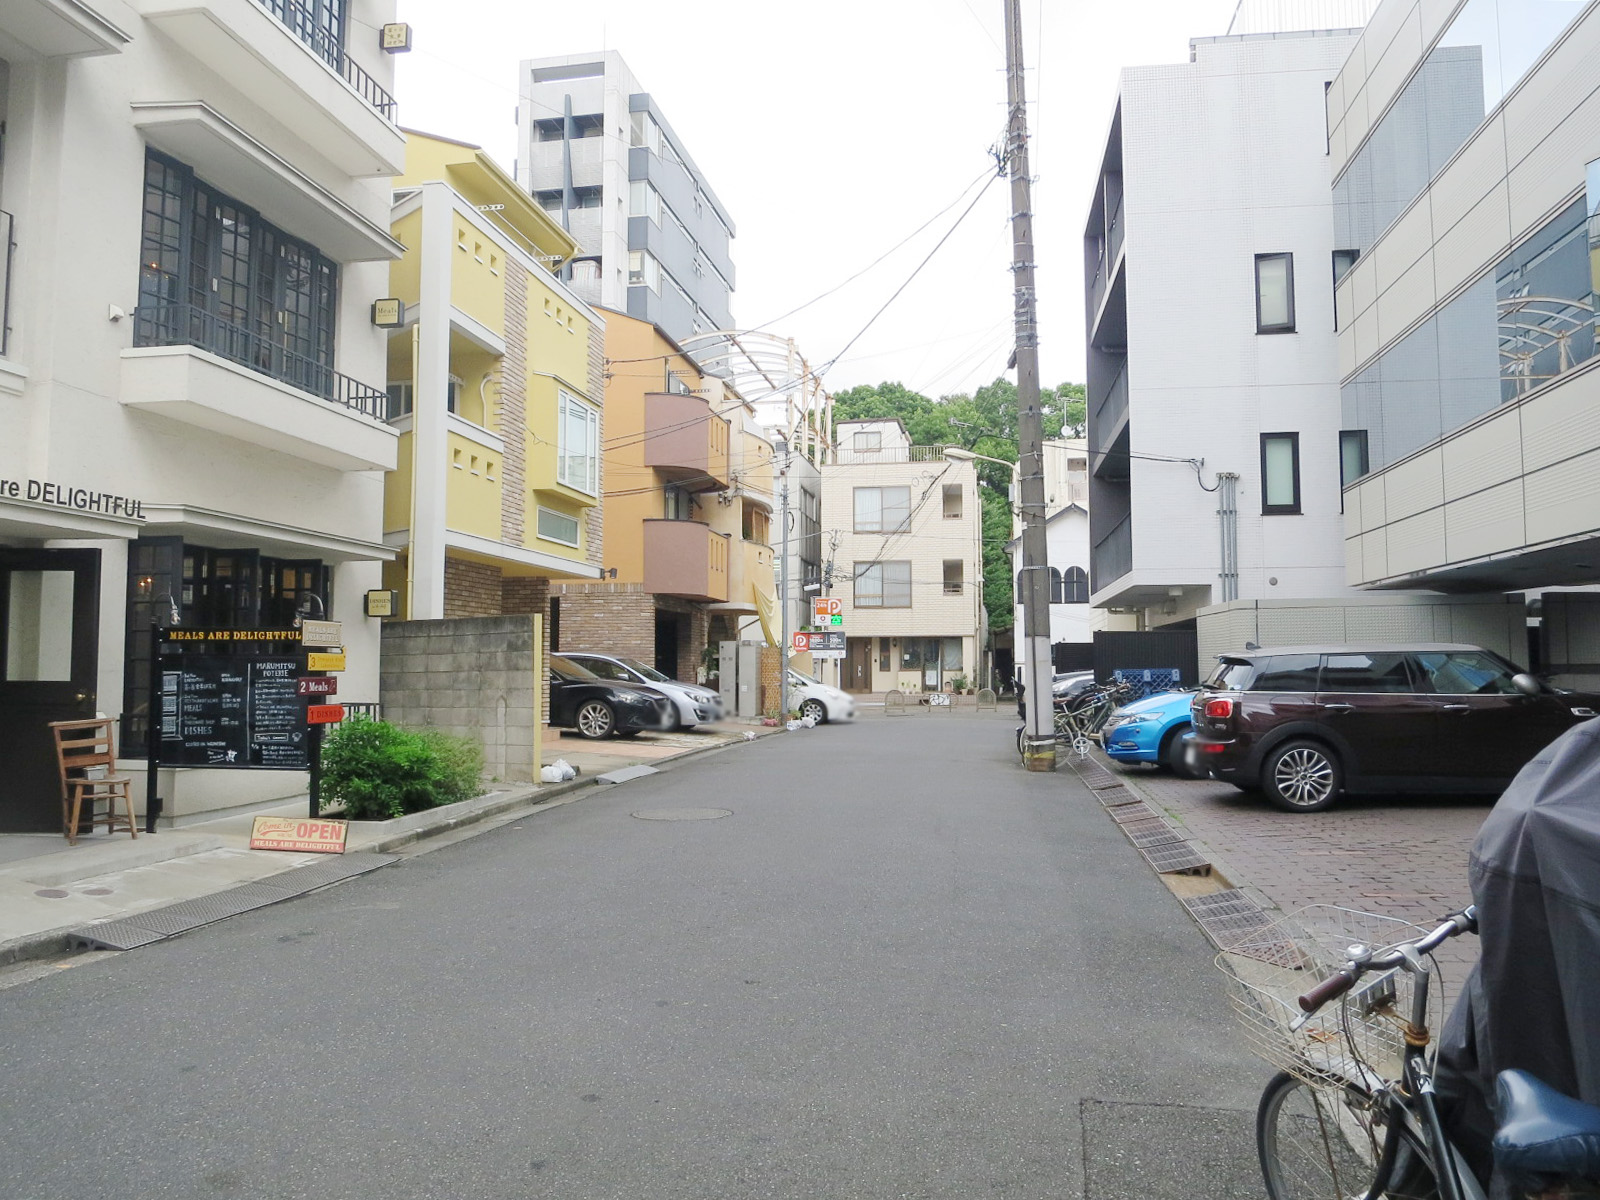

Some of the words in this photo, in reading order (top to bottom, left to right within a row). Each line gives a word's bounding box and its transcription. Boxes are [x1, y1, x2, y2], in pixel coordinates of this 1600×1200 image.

[27, 479, 146, 520] DELIGHTFUL
[827, 599, 842, 614] P
[169, 631, 205, 640] MEALS
[207, 631, 230, 640] ARE
[233, 631, 302, 640] DELIGHTFUL
[795, 635, 807, 647] P
[310, 656, 316, 668] 3
[300, 681, 306, 693] 2
[309, 681, 329, 692] Meals
[311, 710, 314, 721] 1
[317, 710, 341, 719] DISHES
[184, 726, 212, 735] DISHES
[257, 821, 281, 834] Come
[296, 822, 343, 841] OPEN
[254, 839, 278, 848] MEALS
[295, 842, 341, 851] DELIGHTFUL
